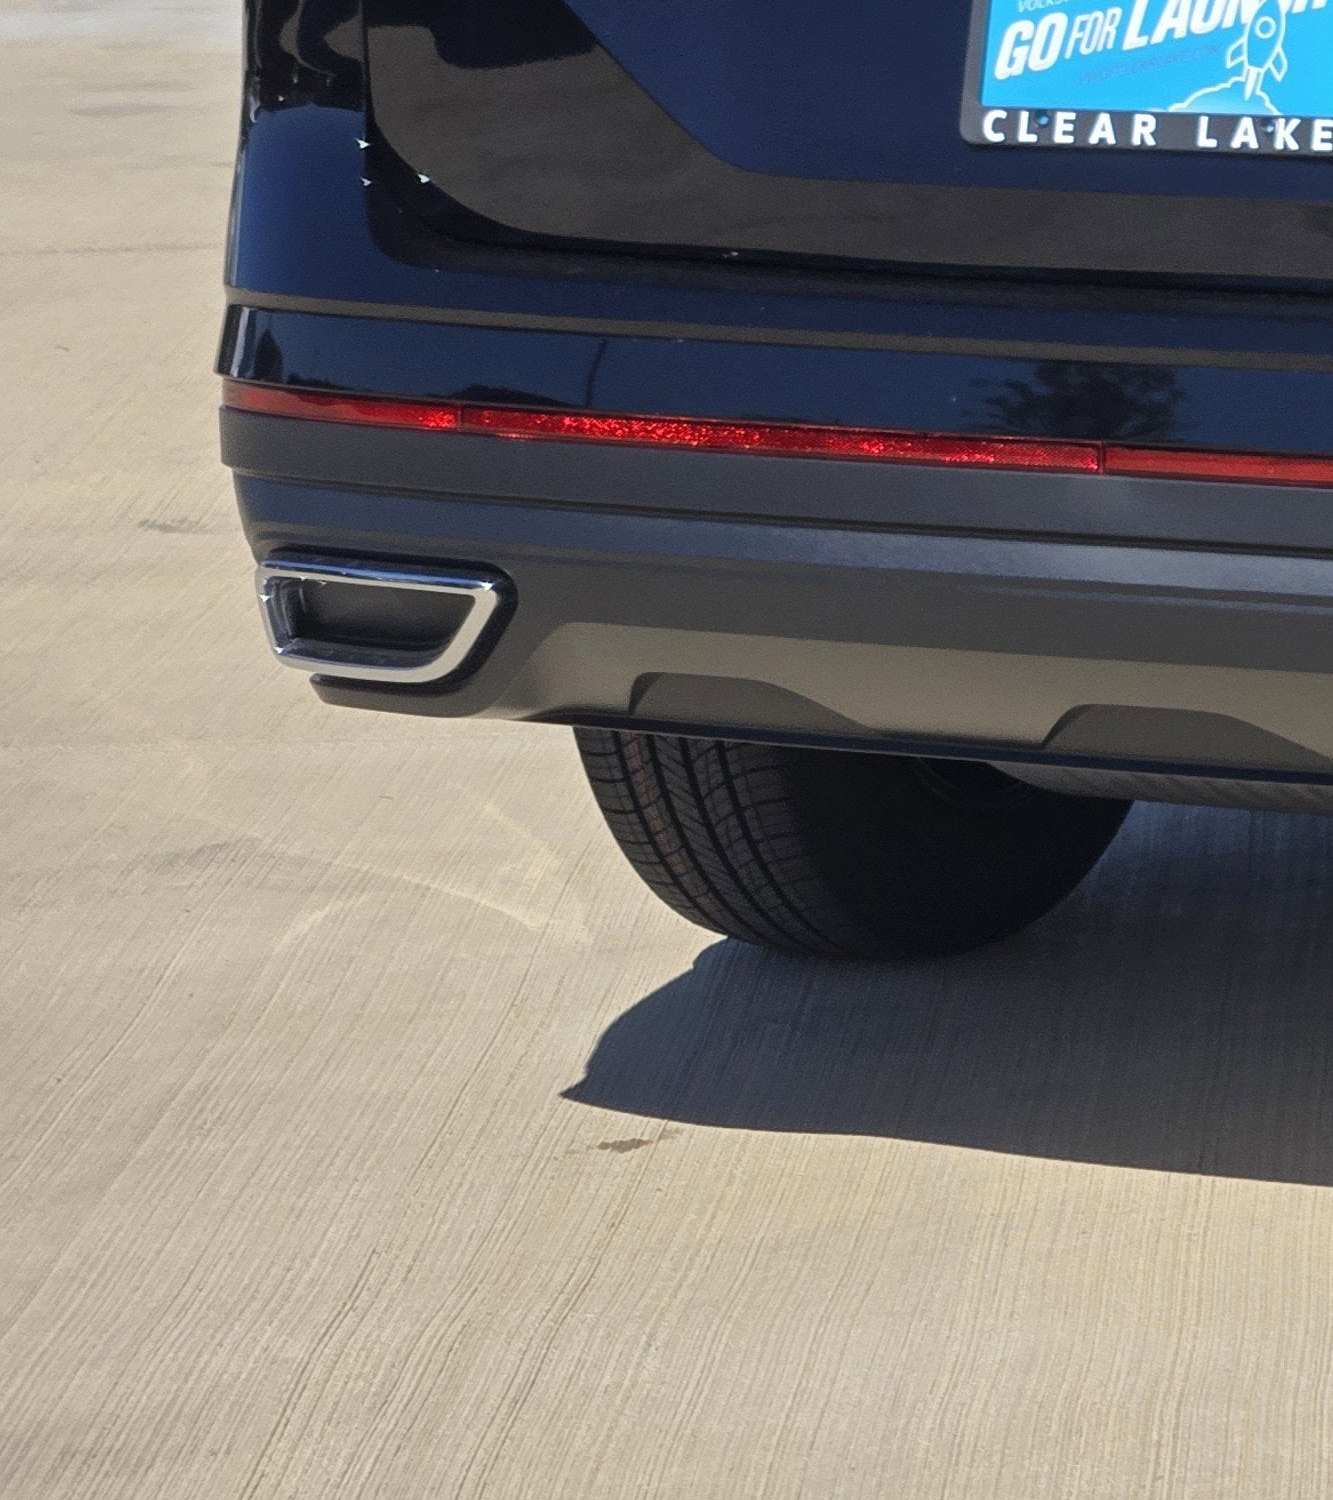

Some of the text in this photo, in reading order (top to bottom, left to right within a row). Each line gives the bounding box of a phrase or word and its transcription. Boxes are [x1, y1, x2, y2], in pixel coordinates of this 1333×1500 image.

[994, 11, 1069, 80] GO
[1064, 5, 1122, 60] FOR
[982, 109, 1157, 147] CLEAR
